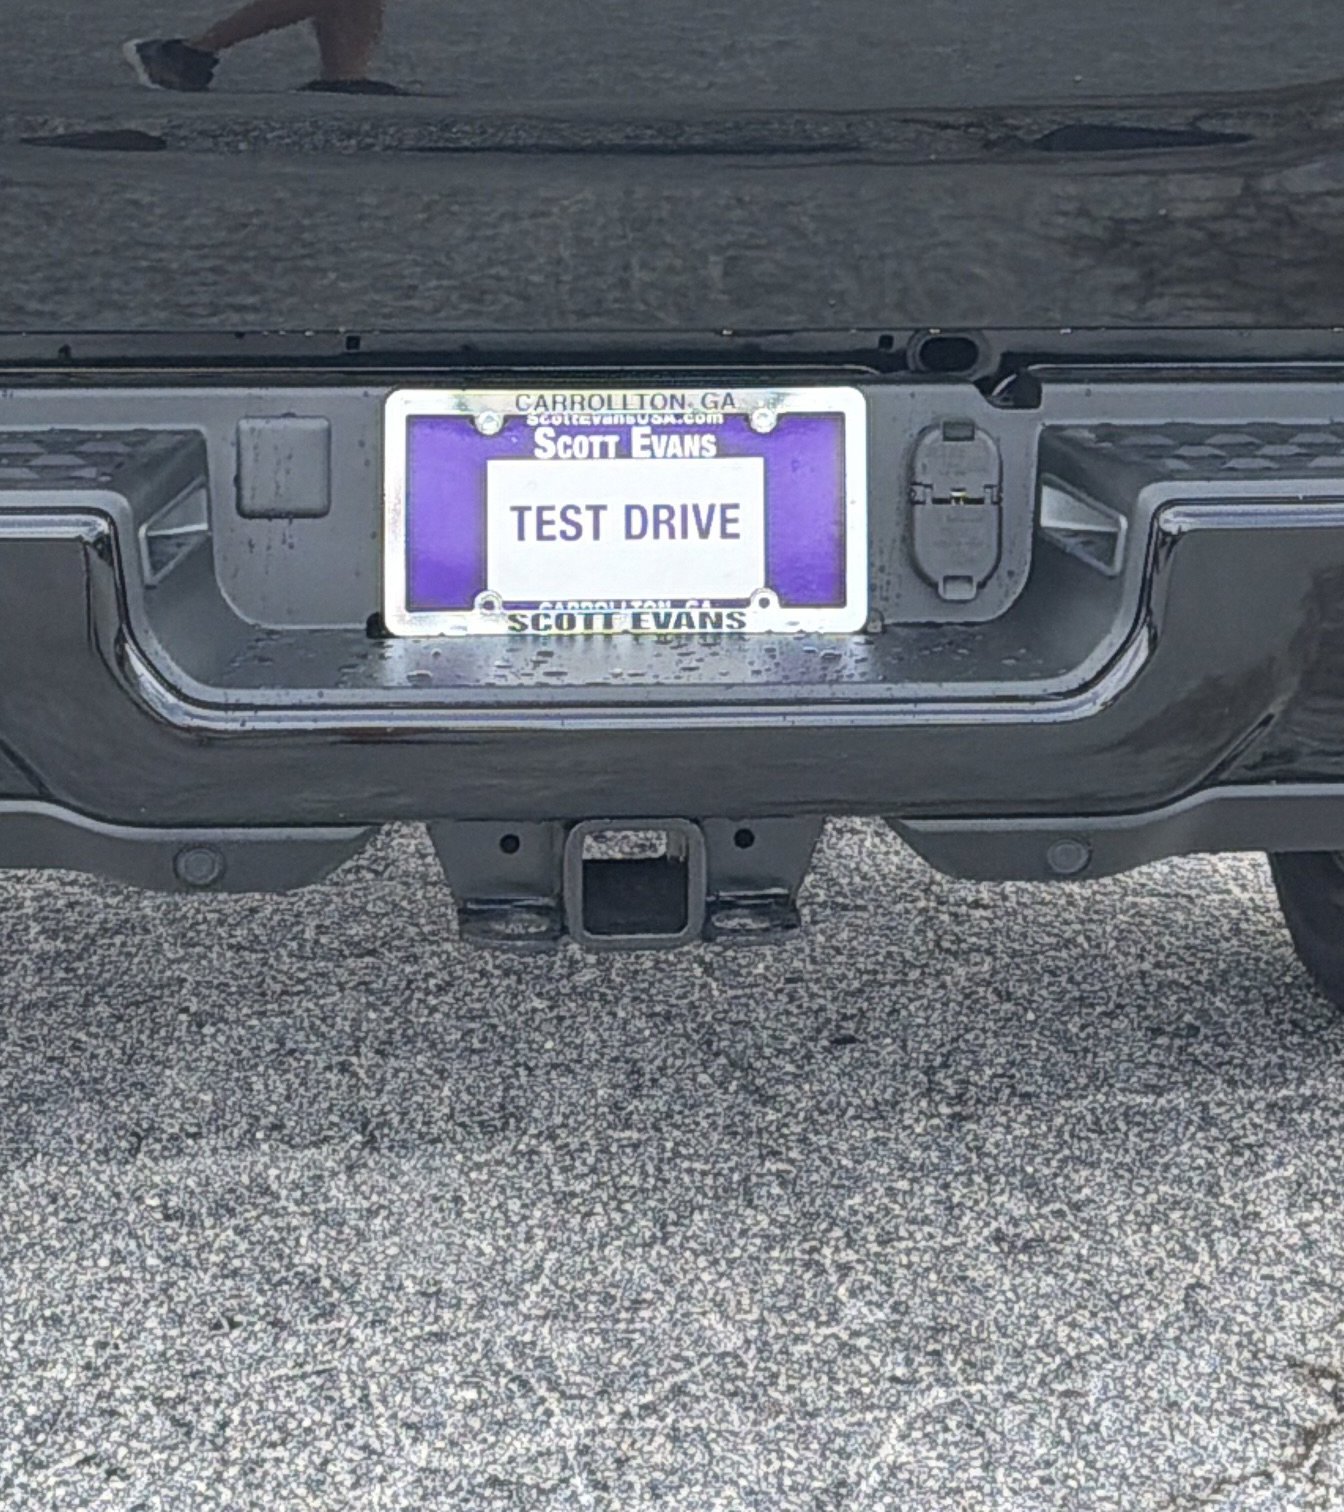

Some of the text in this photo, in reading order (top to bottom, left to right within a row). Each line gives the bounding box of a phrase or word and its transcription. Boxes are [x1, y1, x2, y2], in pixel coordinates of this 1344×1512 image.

[700, 391, 737, 410] GA
[533, 425, 718, 459] SCOTT EVANS
[509, 502, 742, 542] TEST DRIVE
[507, 610, 747, 633] SCOTT EVANS
